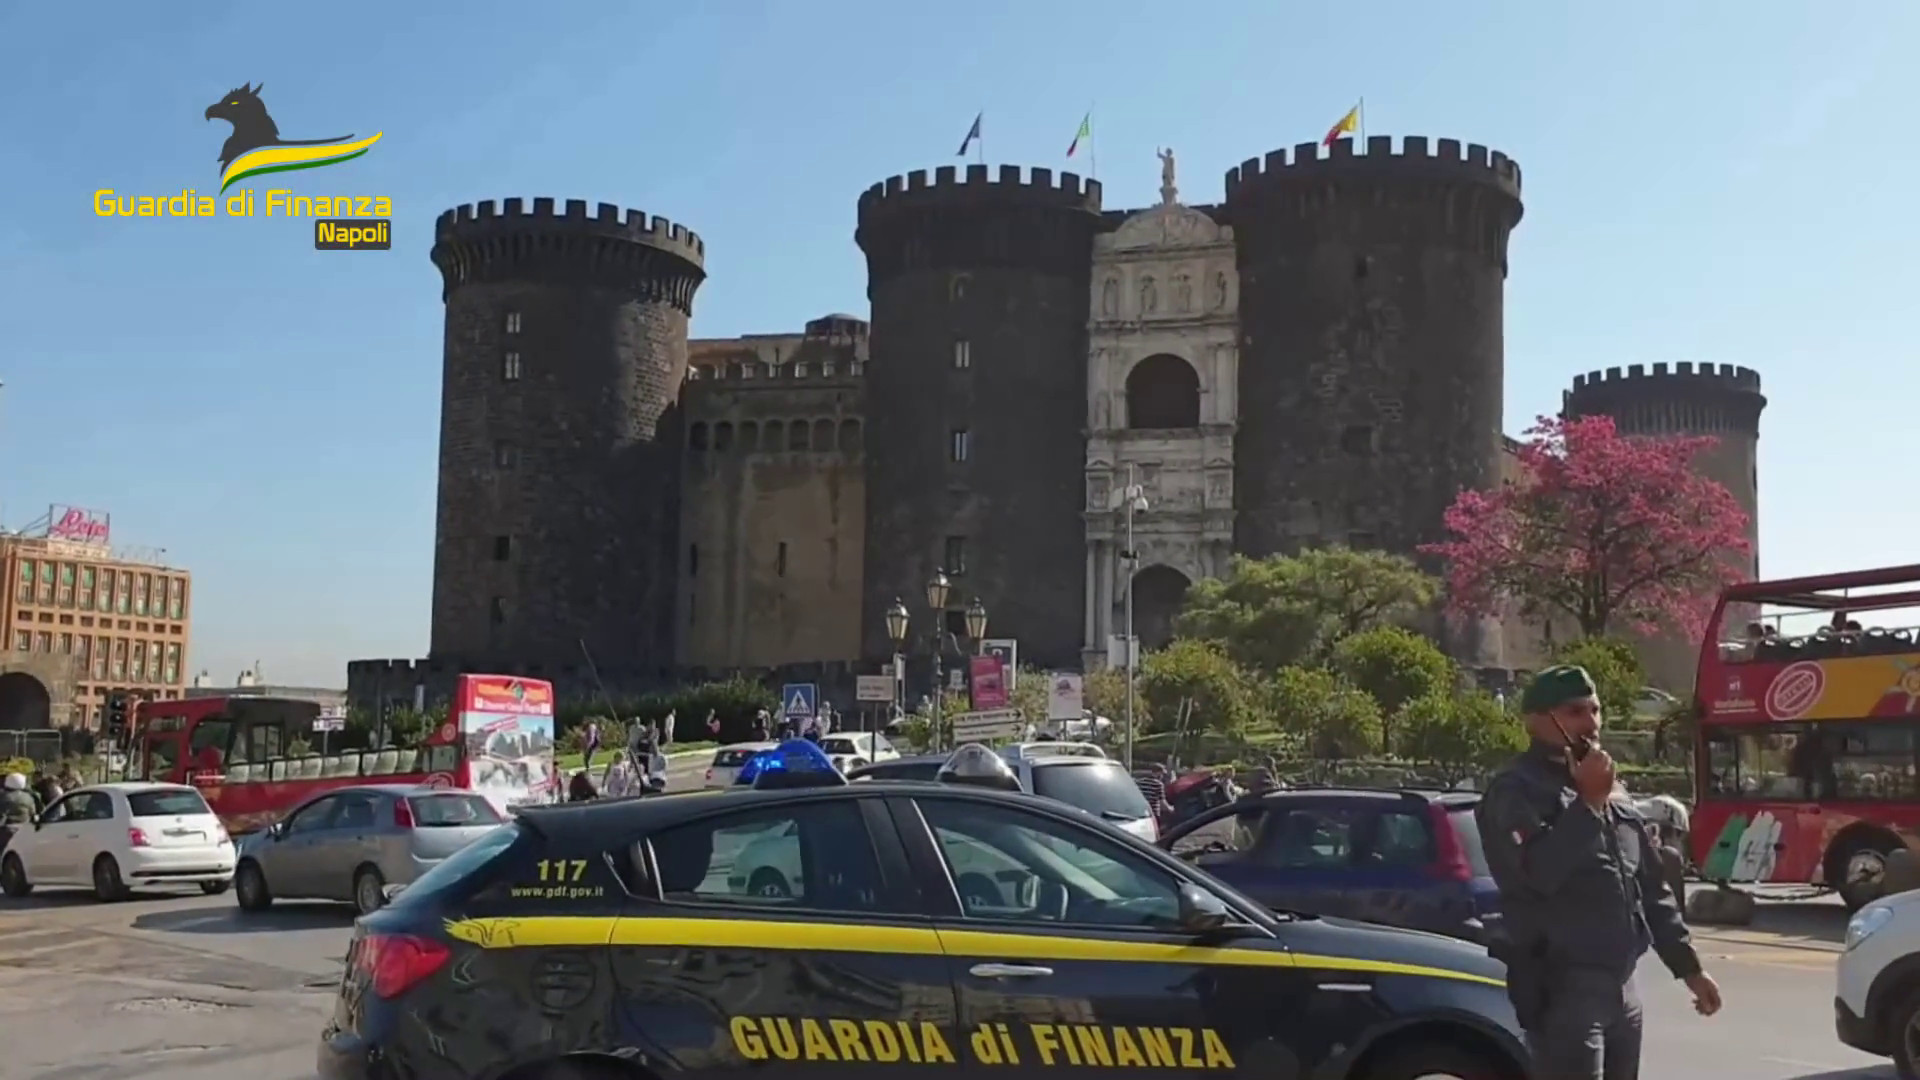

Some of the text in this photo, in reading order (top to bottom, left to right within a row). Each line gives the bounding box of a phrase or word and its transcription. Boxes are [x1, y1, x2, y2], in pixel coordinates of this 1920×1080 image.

[537, 859, 588, 882] 117
[511, 886, 604, 898] www.gdf.gov.it
[730, 1015, 1235, 1068] GUARDIA di FINANZA
